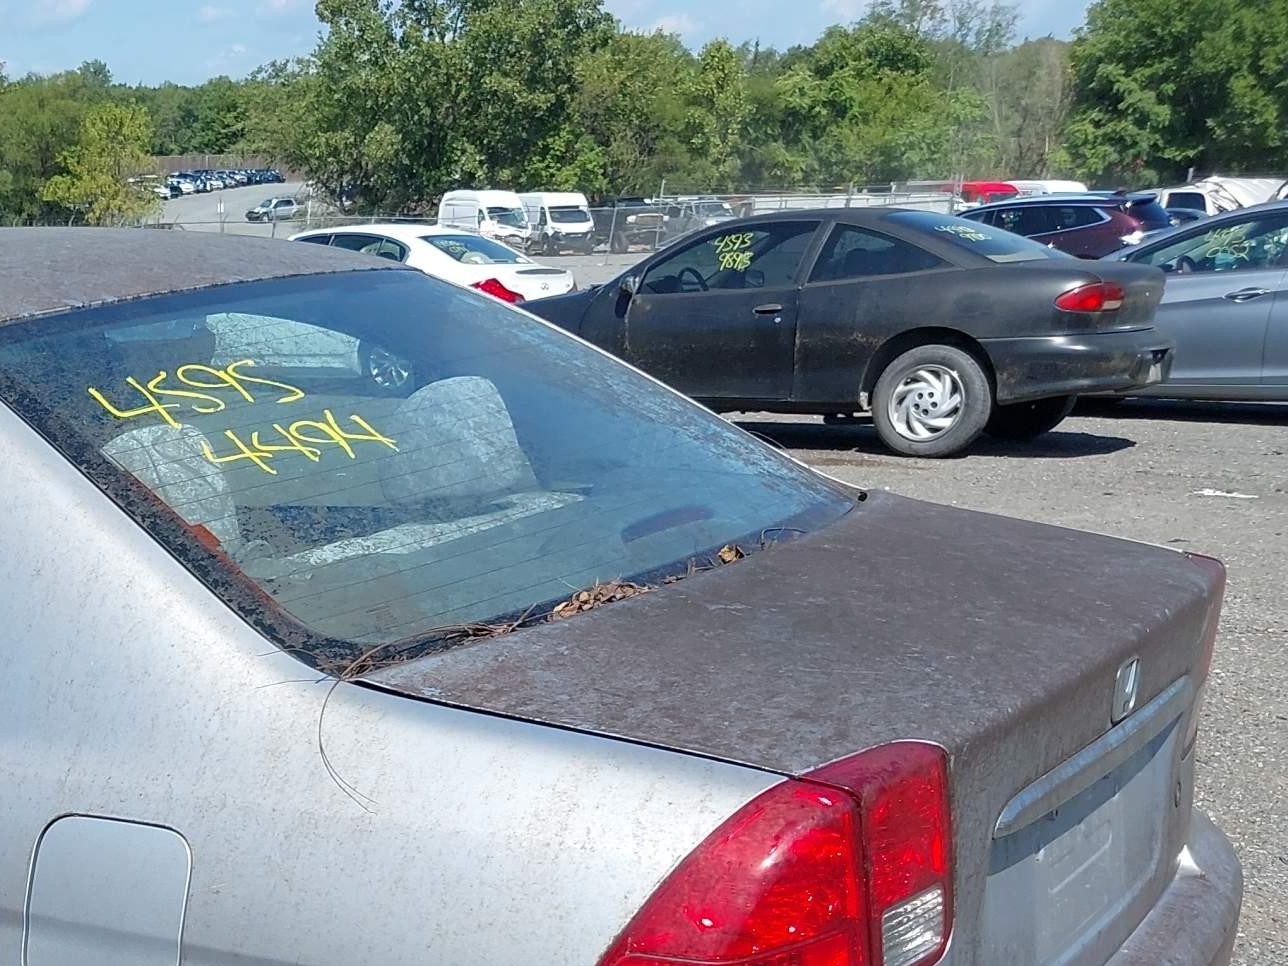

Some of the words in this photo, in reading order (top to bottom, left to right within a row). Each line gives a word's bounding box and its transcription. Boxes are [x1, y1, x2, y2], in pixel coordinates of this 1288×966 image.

[714, 232, 754, 254] 4593
[88, 359, 305, 430] 4595
[200, 409, 400, 475] 4494
